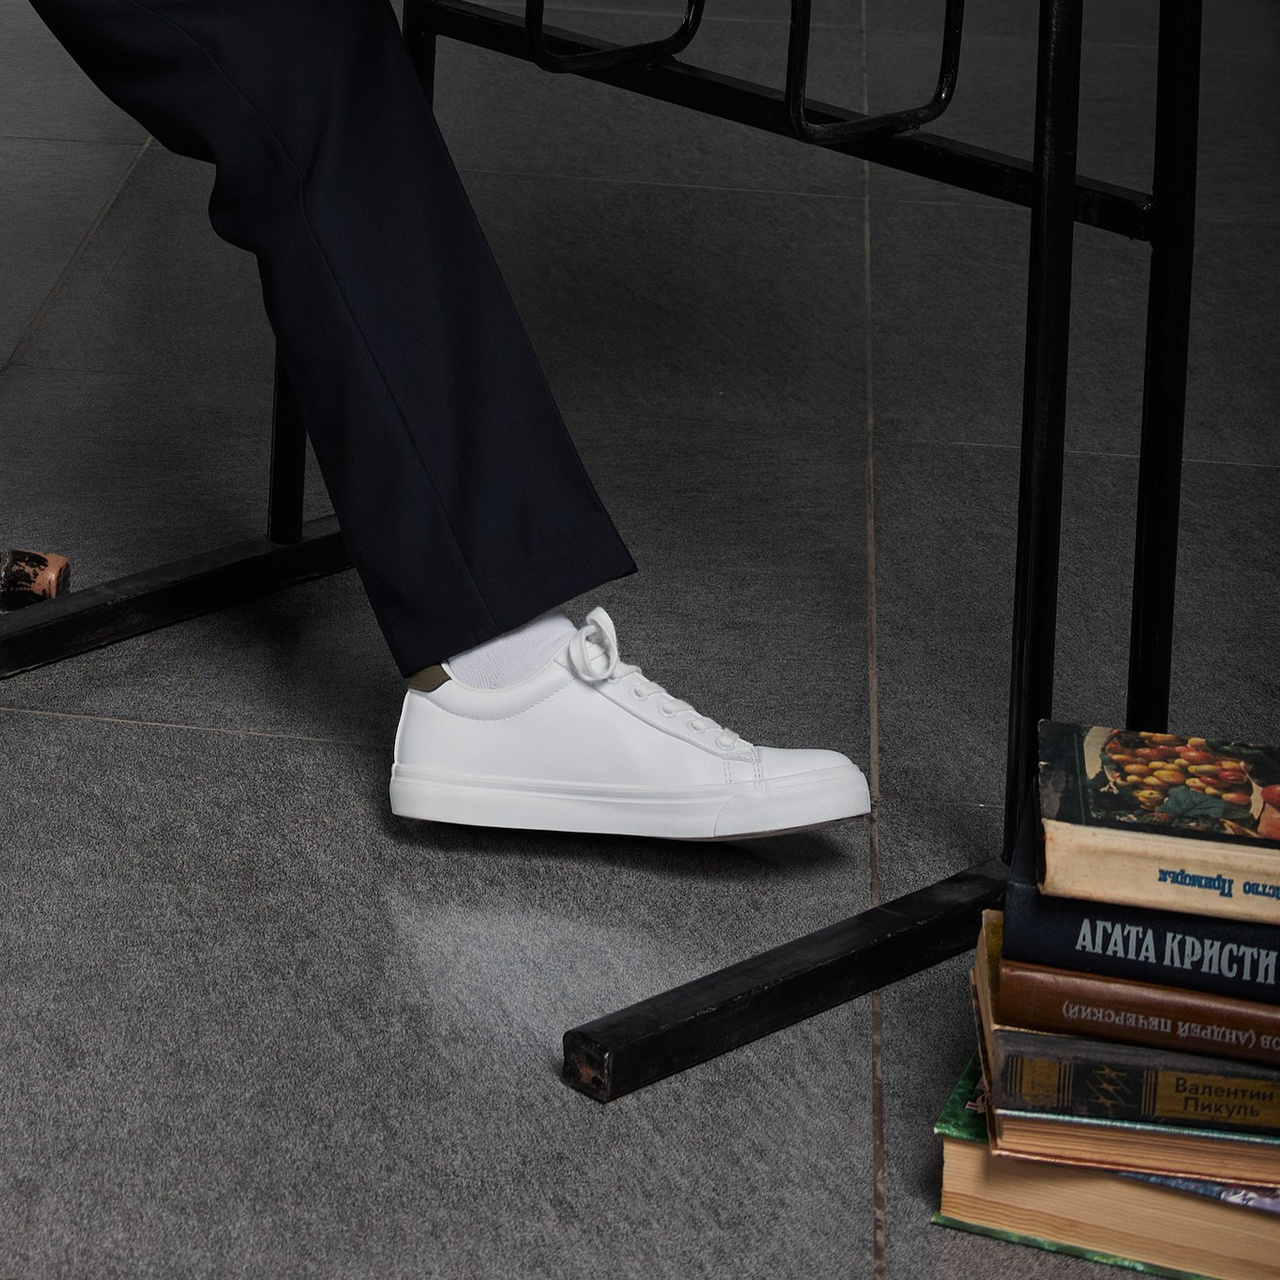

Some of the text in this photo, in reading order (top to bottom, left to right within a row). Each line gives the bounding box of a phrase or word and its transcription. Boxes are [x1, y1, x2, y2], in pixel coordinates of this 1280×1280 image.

[1158, 868, 1233, 898] Приморья
[1074, 917, 1280, 987] АГАТА КРИСТИ
[1062, 1000, 1172, 1035] ПЕЧЕРСКИЙ)
[1176, 1018, 1257, 1050] (АНДРЕЙ
[1174, 1076, 1275, 1103] Валентин
[1183, 1095, 1261, 1120] Пикуль
